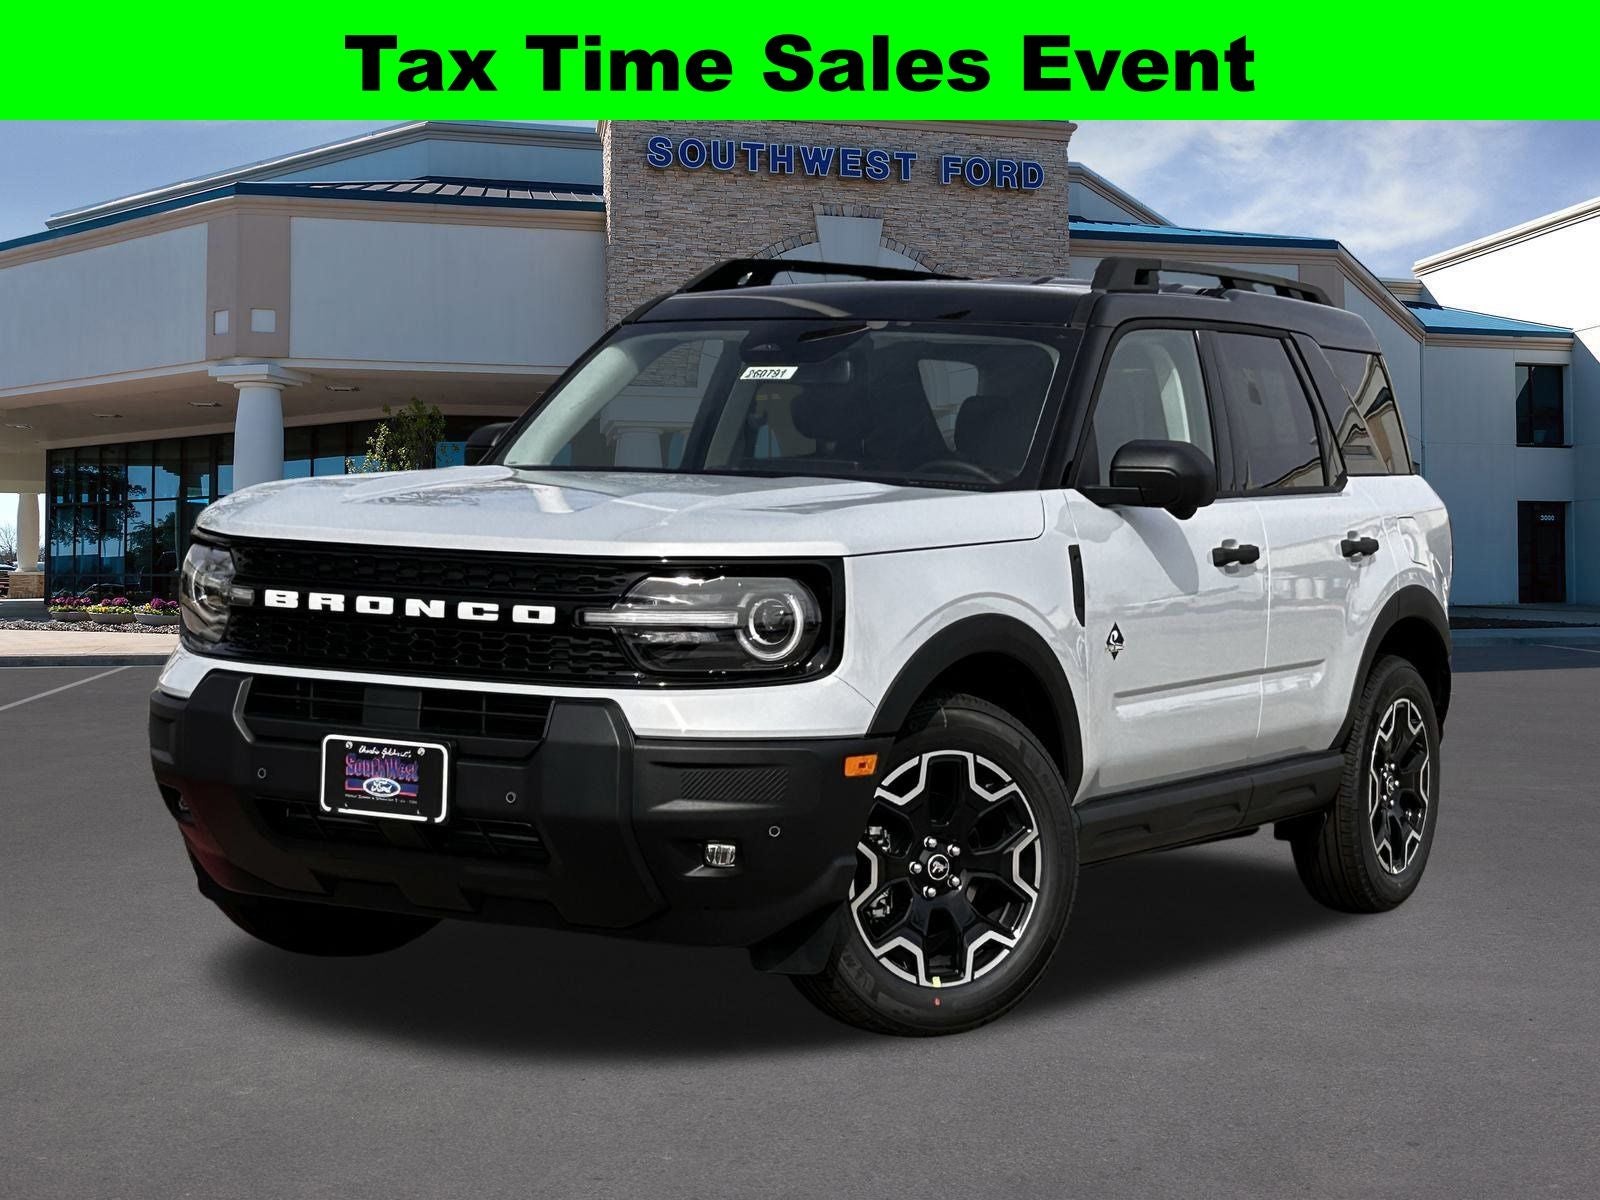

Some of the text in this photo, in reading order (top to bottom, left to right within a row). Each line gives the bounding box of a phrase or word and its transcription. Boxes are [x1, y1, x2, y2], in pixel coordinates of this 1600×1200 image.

[646, 134, 1046, 191] SOUTHWEST FORD
[264, 589, 556, 625] BRONCO
